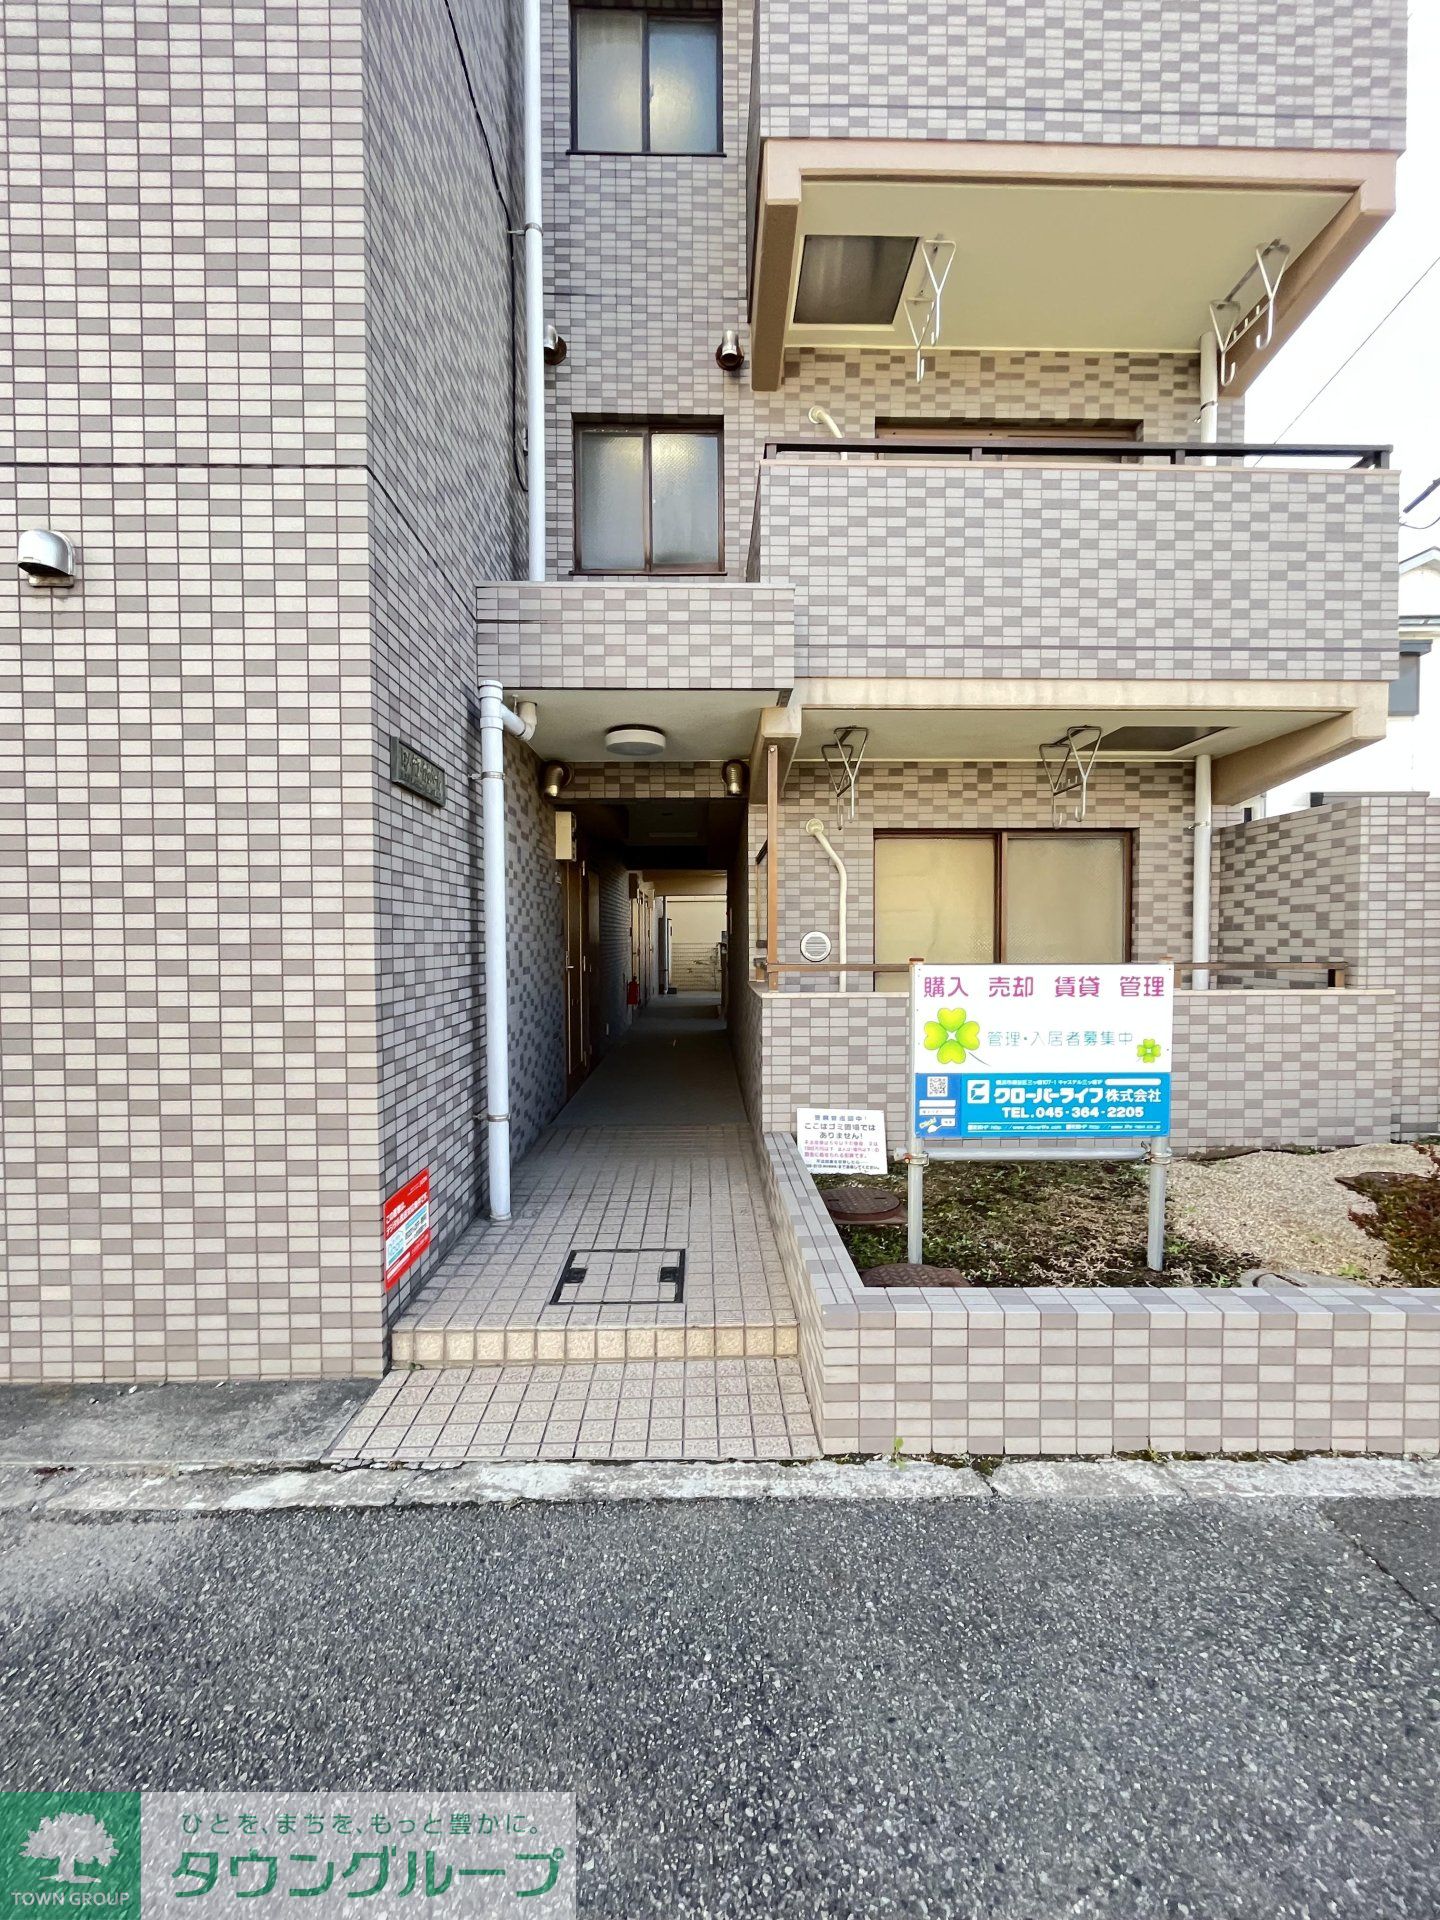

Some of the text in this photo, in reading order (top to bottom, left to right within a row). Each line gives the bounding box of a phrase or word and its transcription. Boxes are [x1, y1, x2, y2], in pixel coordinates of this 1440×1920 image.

[923, 975, 1165, 998] 購入 売却 賃貸 管理
